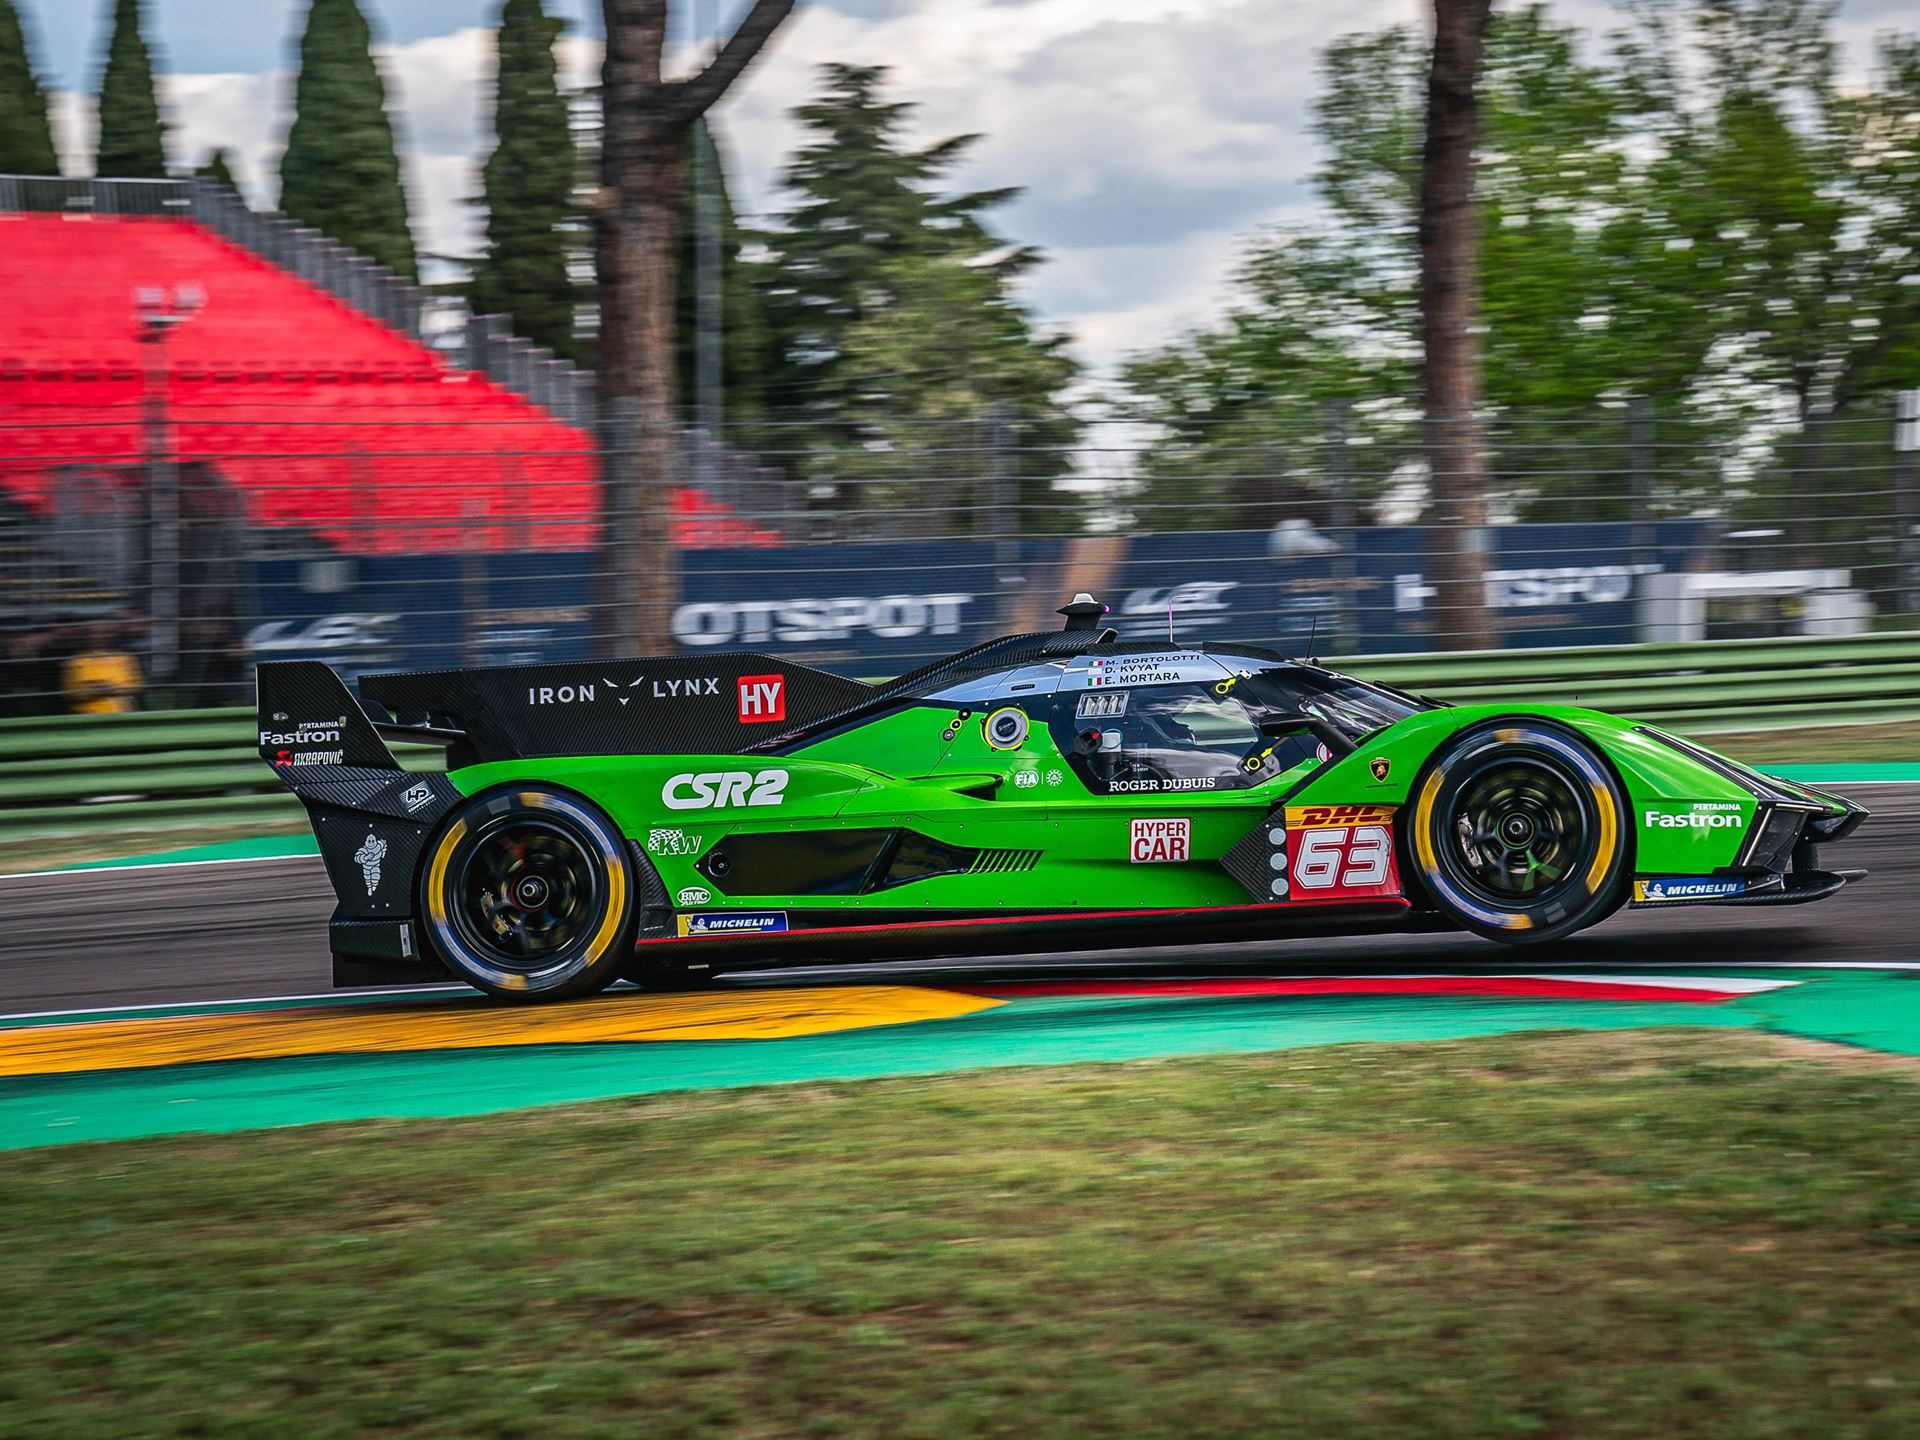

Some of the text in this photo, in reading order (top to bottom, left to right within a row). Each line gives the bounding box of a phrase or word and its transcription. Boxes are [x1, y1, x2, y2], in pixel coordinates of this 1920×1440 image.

[671, 593, 974, 645] OTSPOT
[1123, 655, 1200, 665] BORTOLOTTI
[1120, 664, 1160, 673] KVYAT
[1105, 672, 1180, 685] E. MORTARA
[528, 677, 720, 705] IRON LYNX
[740, 682, 781, 716] HY
[260, 730, 340, 745] Fastron
[661, 769, 790, 810] CSR2
[1108, 777, 1216, 792] ROGER DUBUIS
[1692, 803, 1741, 811] PERTAMINA
[1301, 806, 1385, 826] DHL
[1645, 811, 1742, 828] Fastron
[1134, 822, 1186, 837] HYPER
[657, 835, 702, 855] KW
[1134, 837, 1185, 861] CAR
[1293, 826, 1391, 889] 63
[681, 891, 708, 901] BMC
[1666, 883, 1737, 895] MICHELIN
[709, 917, 774, 929] MICHELIN
